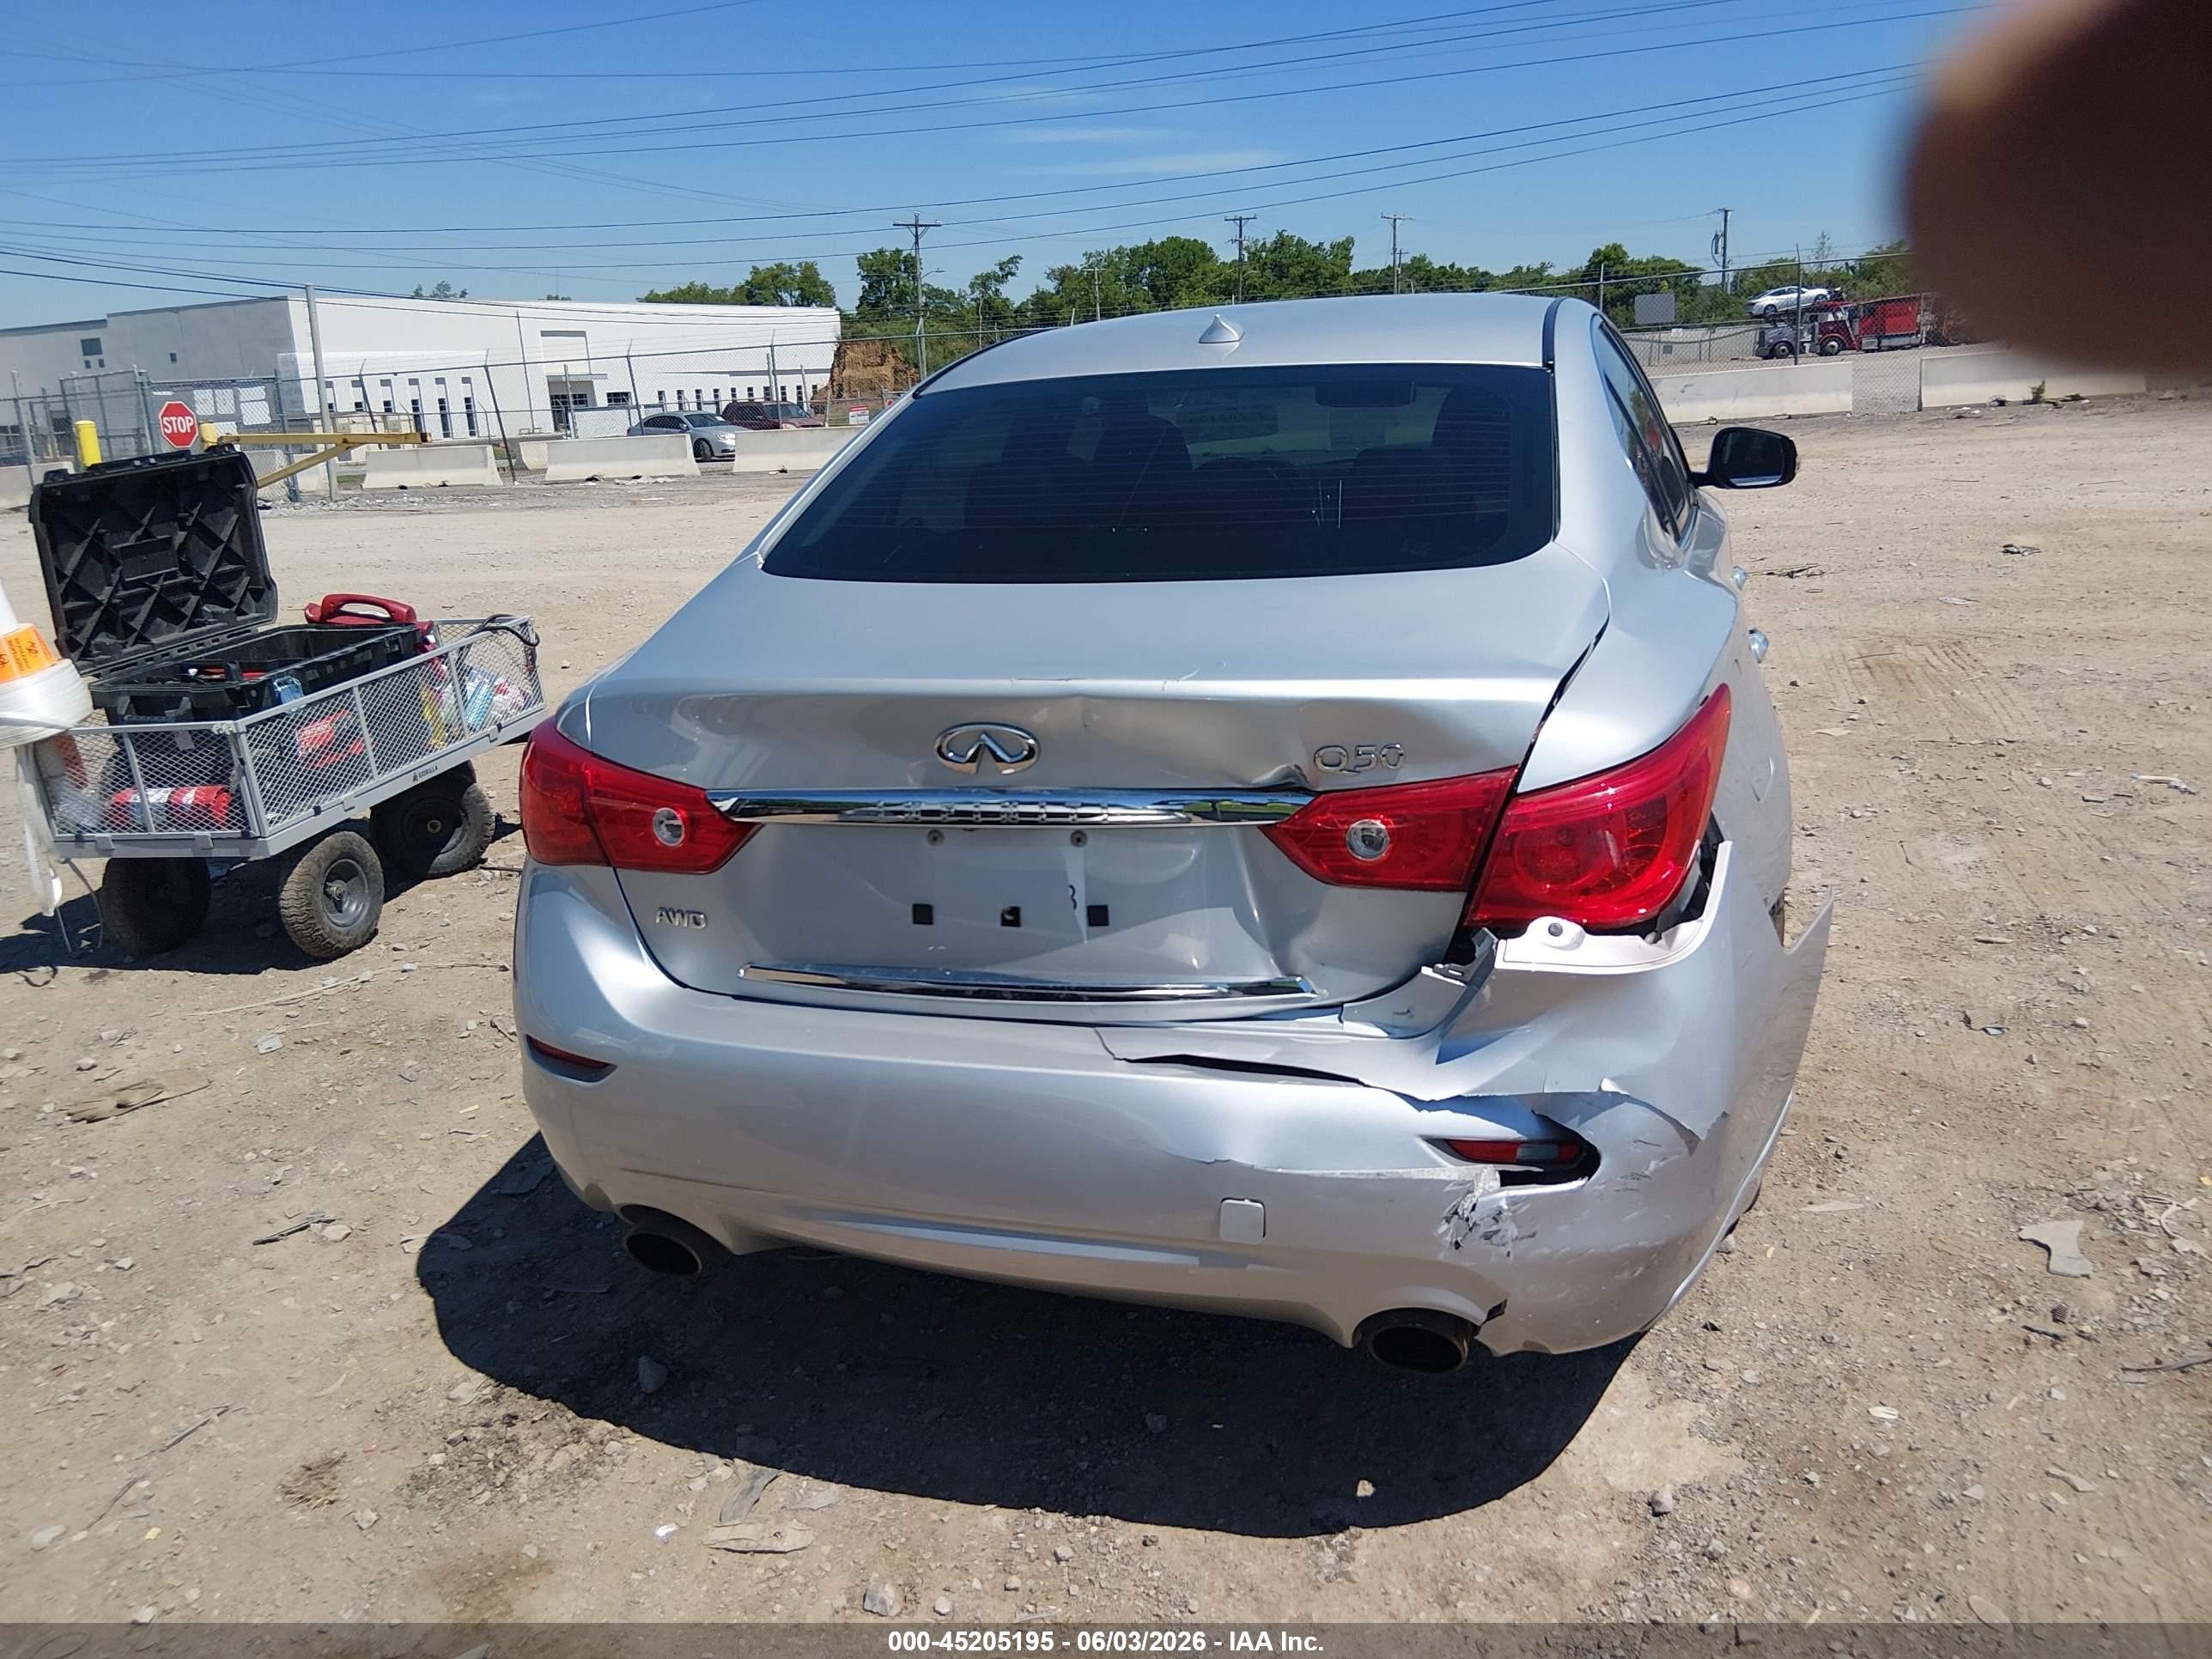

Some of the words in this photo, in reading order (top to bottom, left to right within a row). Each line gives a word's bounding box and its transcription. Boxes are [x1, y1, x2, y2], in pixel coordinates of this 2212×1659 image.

[162, 416, 194, 434] STOP
[1313, 743, 1406, 776] Q50
[418, 764, 439, 779] GORILLA
[655, 906, 708, 929] AWD
